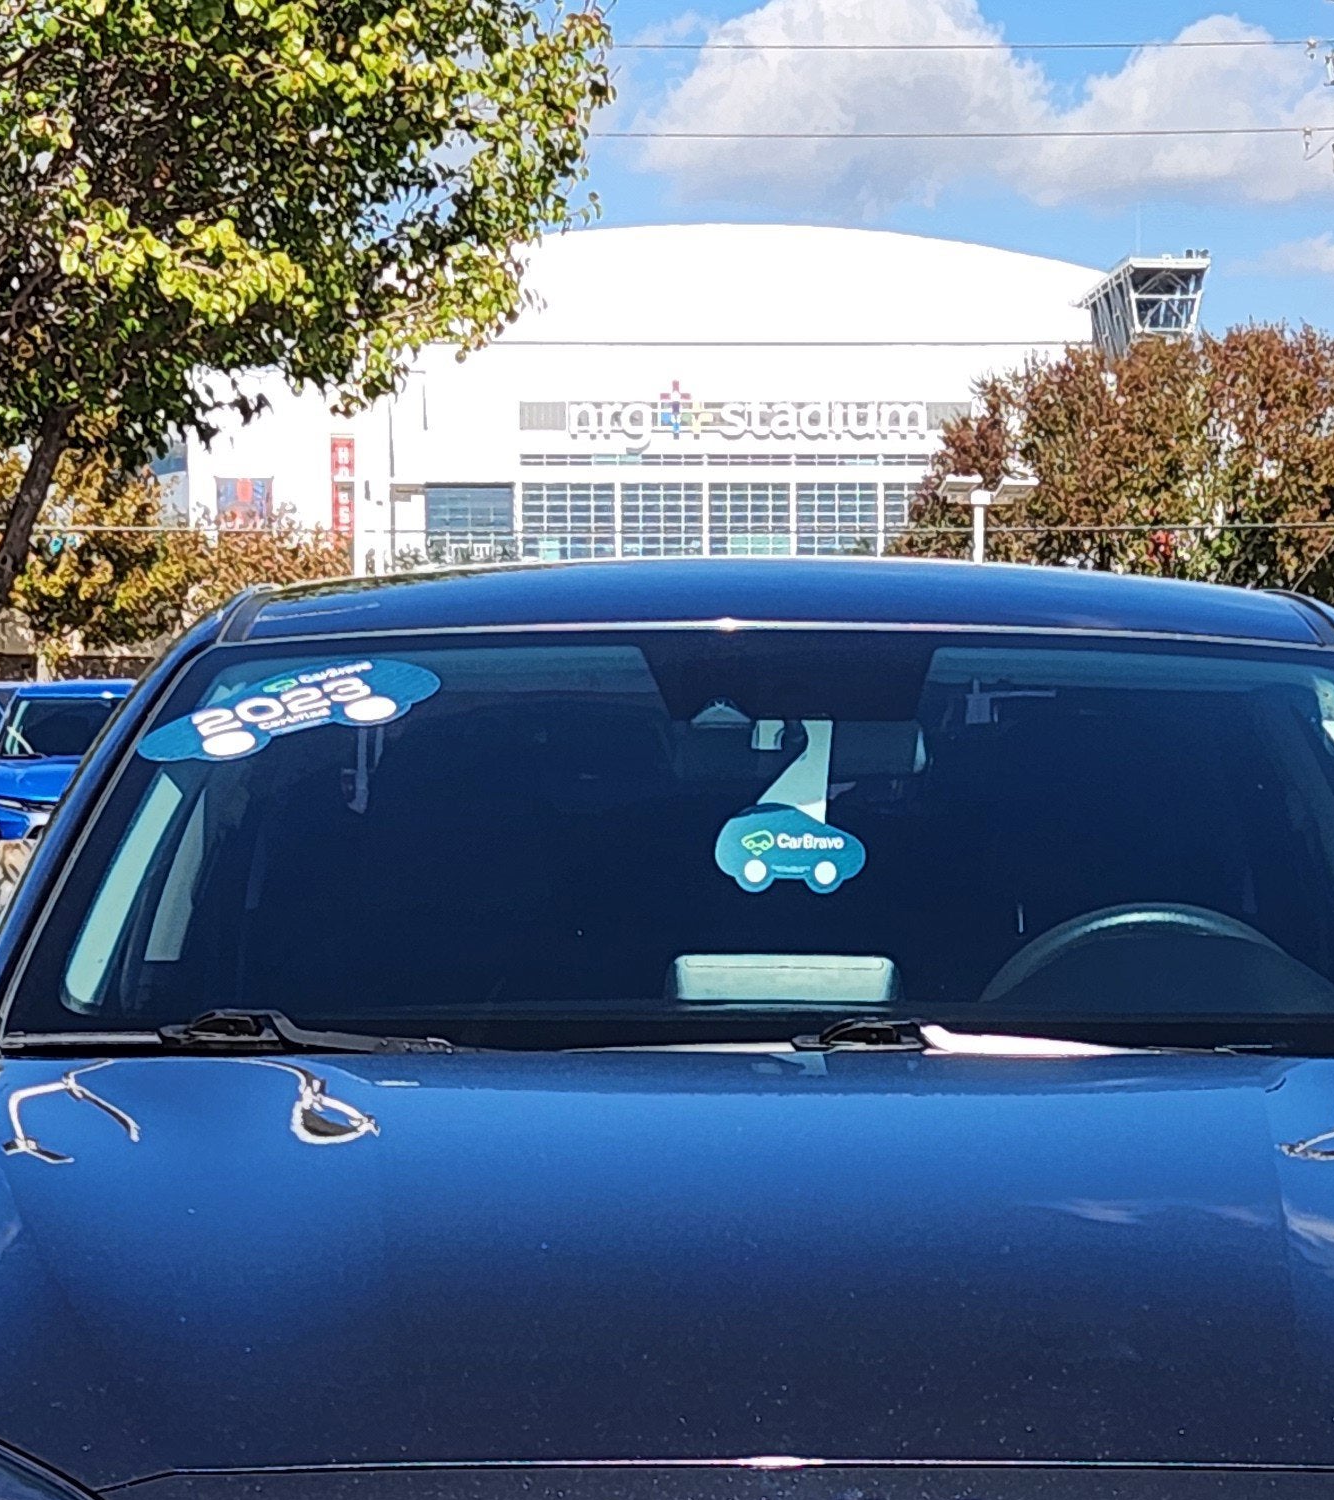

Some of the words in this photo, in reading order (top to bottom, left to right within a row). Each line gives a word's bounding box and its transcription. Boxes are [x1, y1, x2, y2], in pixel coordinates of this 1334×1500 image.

[568, 401, 652, 449] nrg
[720, 399, 926, 435] stadium
[191, 677, 371, 737] 2023
[776, 832, 845, 850] CarBravo
